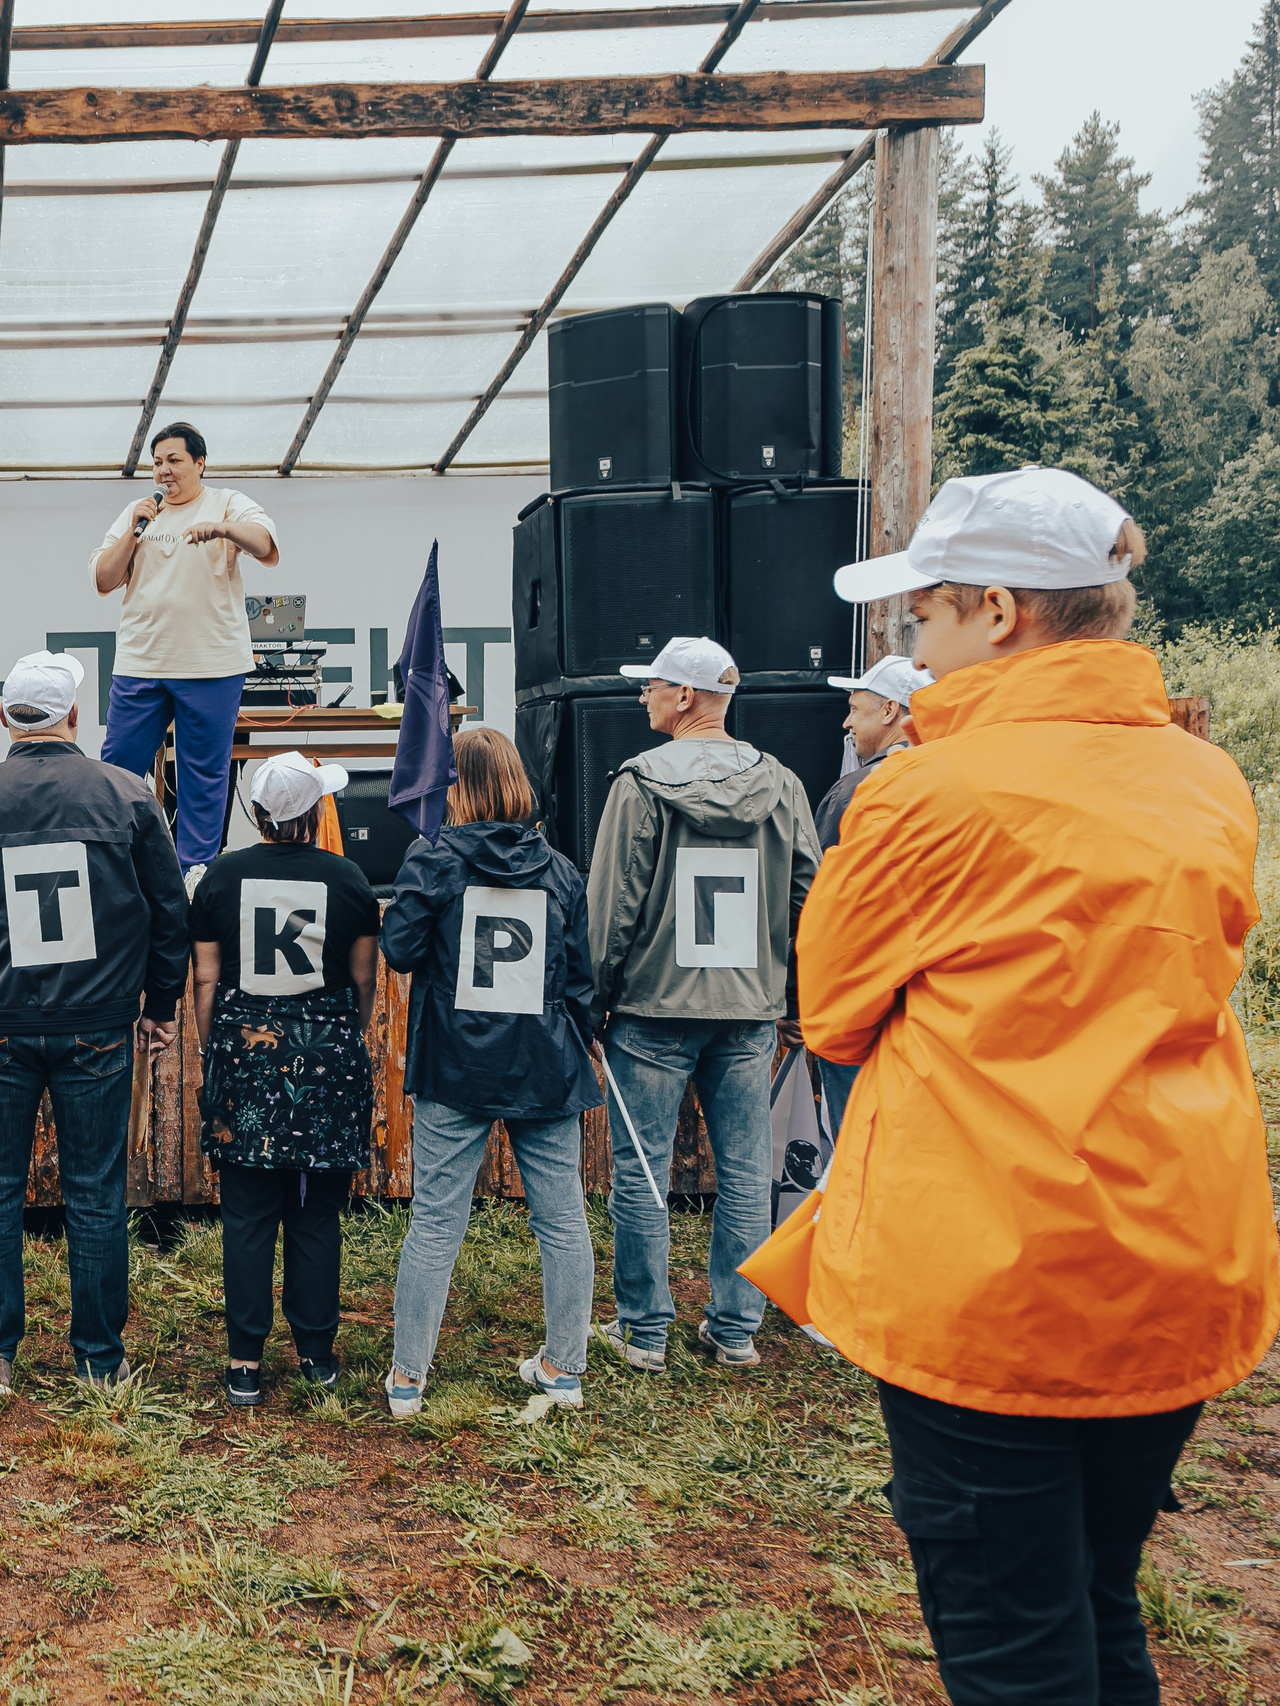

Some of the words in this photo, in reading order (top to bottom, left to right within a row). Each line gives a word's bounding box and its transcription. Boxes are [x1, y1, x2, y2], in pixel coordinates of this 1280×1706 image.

[14, 870, 80, 942] Т
[253, 907, 317, 975] К
[694, 876, 745, 945] Г
[472, 916, 533, 989] Р
